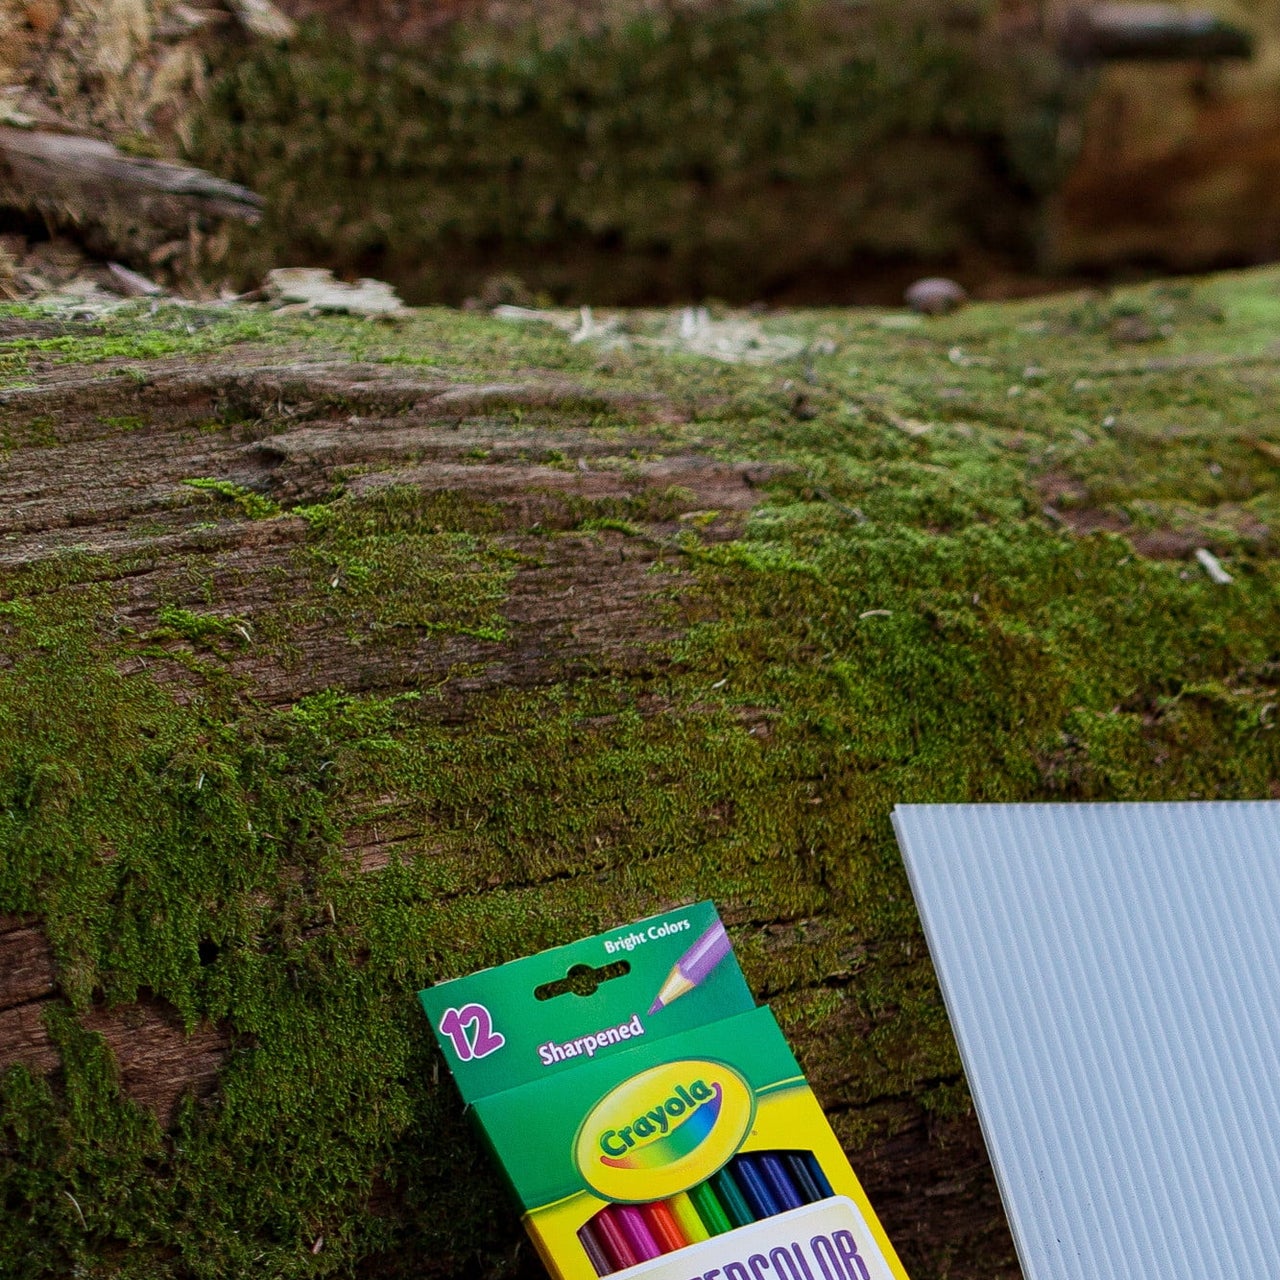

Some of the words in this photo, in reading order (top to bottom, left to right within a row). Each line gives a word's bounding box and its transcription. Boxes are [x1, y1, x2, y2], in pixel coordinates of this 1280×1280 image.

[604, 932, 647, 954] Bright
[648, 918, 691, 940] Colors
[439, 1003, 505, 1062] 12
[537, 1014, 645, 1066] Sharpened
[600, 1080, 713, 1156] Crayola
